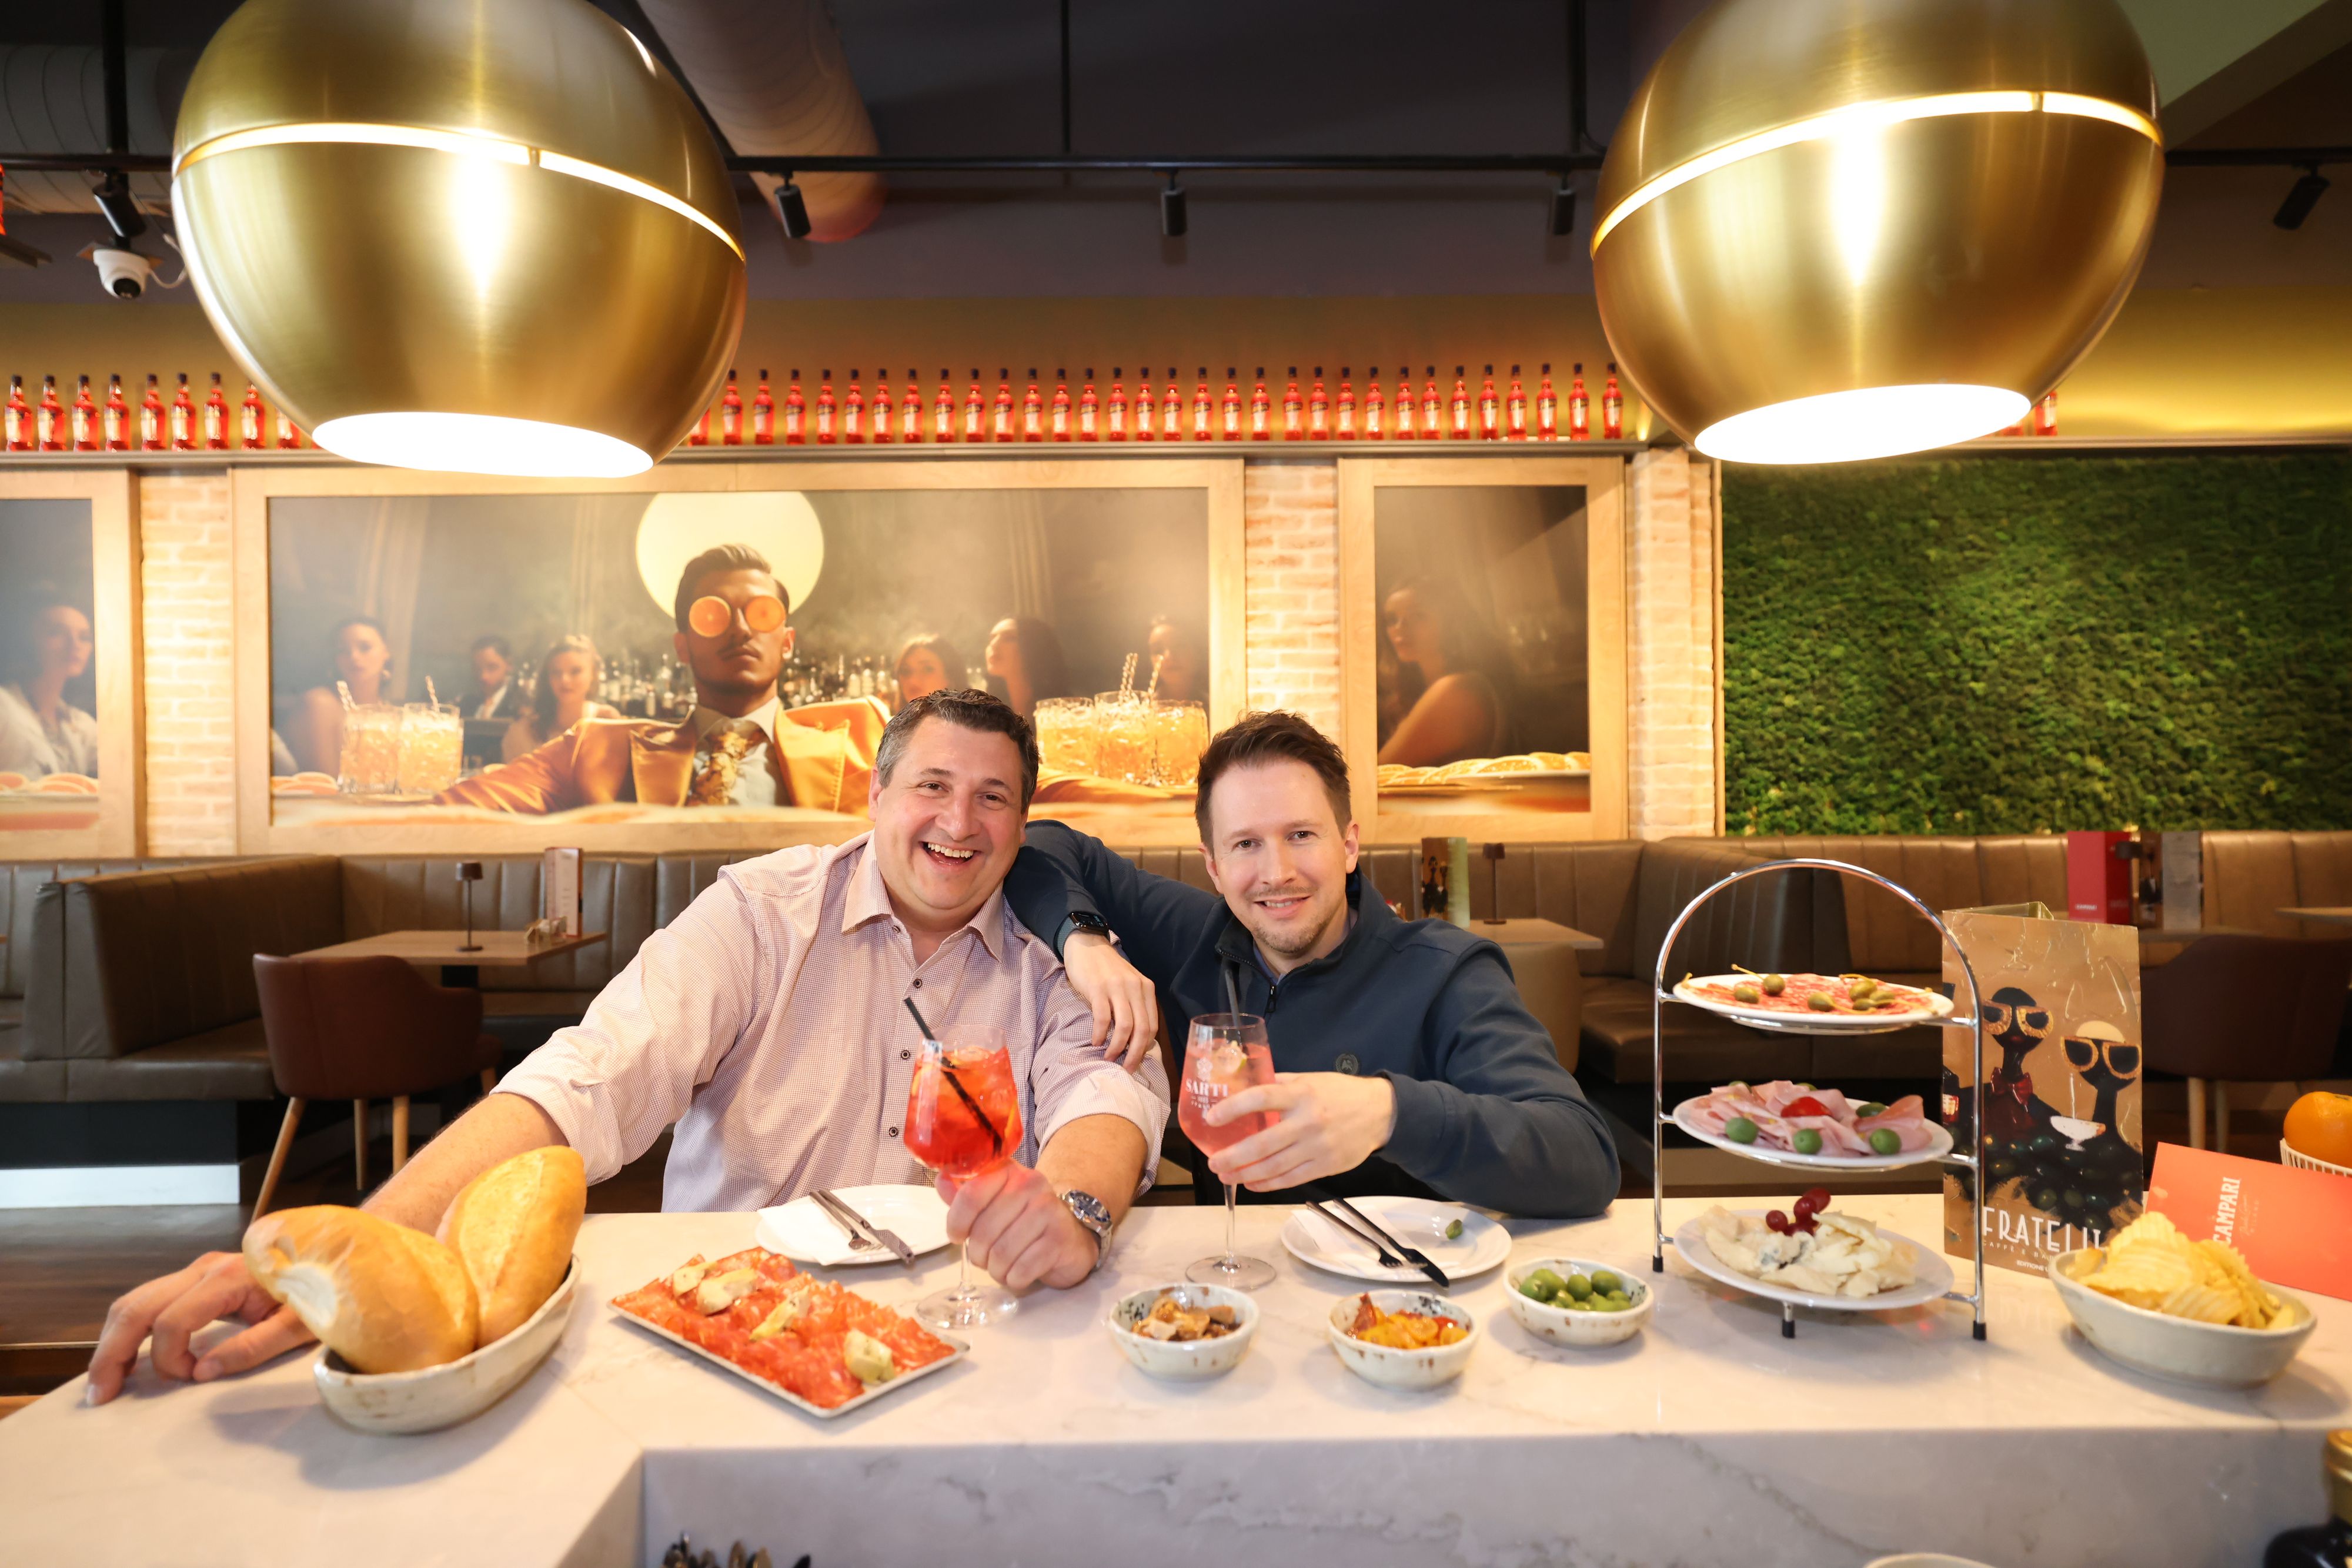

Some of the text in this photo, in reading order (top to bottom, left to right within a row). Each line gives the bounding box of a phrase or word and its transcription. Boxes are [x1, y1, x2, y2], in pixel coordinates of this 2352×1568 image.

[1185, 1078, 1228, 1098] SARTI
[1982, 1206, 2102, 1253] FRATELLI
[2213, 1177, 2241, 1245] CAMPARI
